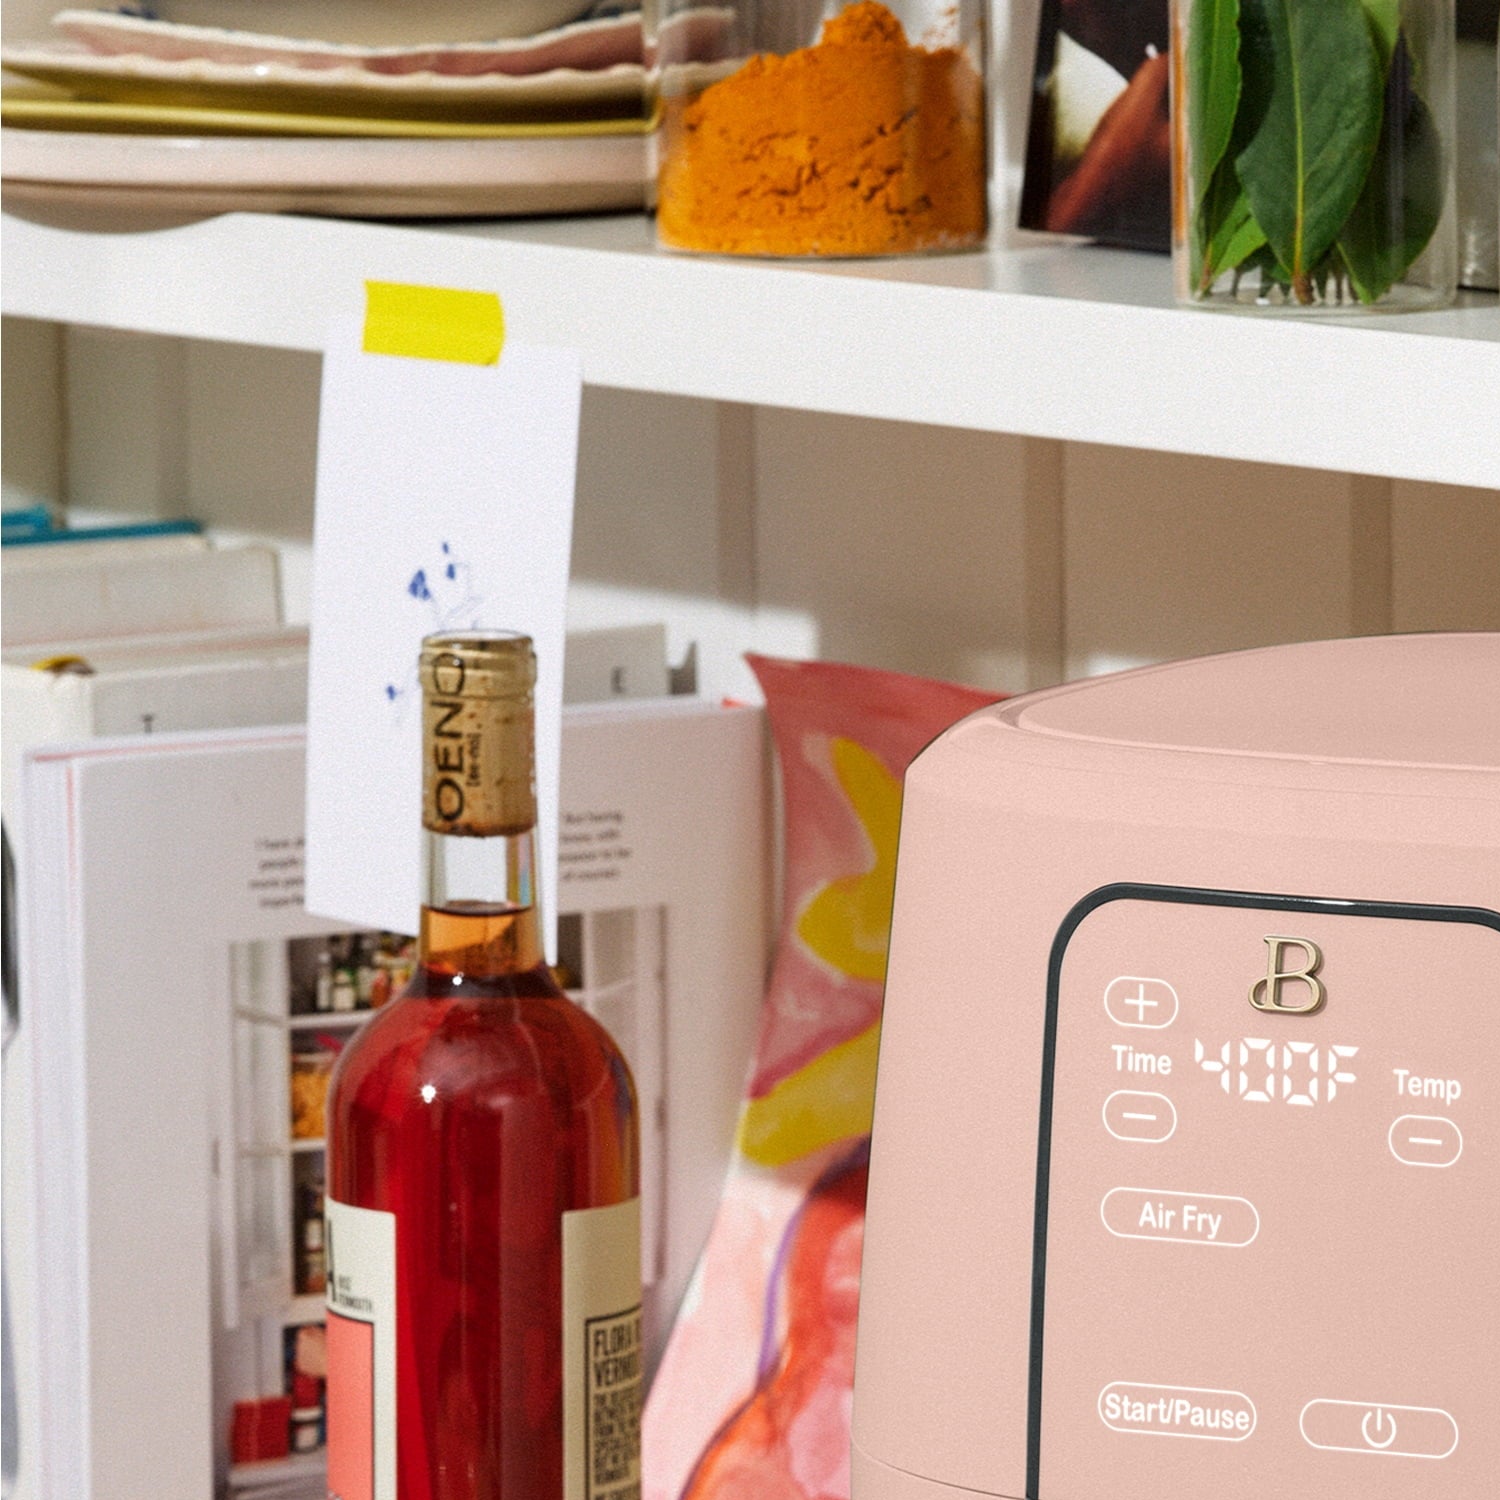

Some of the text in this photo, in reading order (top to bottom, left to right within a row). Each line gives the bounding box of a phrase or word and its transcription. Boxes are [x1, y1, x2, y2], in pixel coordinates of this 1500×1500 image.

[430, 651, 466, 823] OENO
[1247, 933, 1325, 1015] B
[1111, 1044, 1172, 1076] Time
[1194, 1037, 1360, 1106] 400F
[1393, 1068, 1462, 1105] Temp
[1138, 1201, 1222, 1238] Air Fry
[1104, 1393, 1251, 1433] Start/Pause
